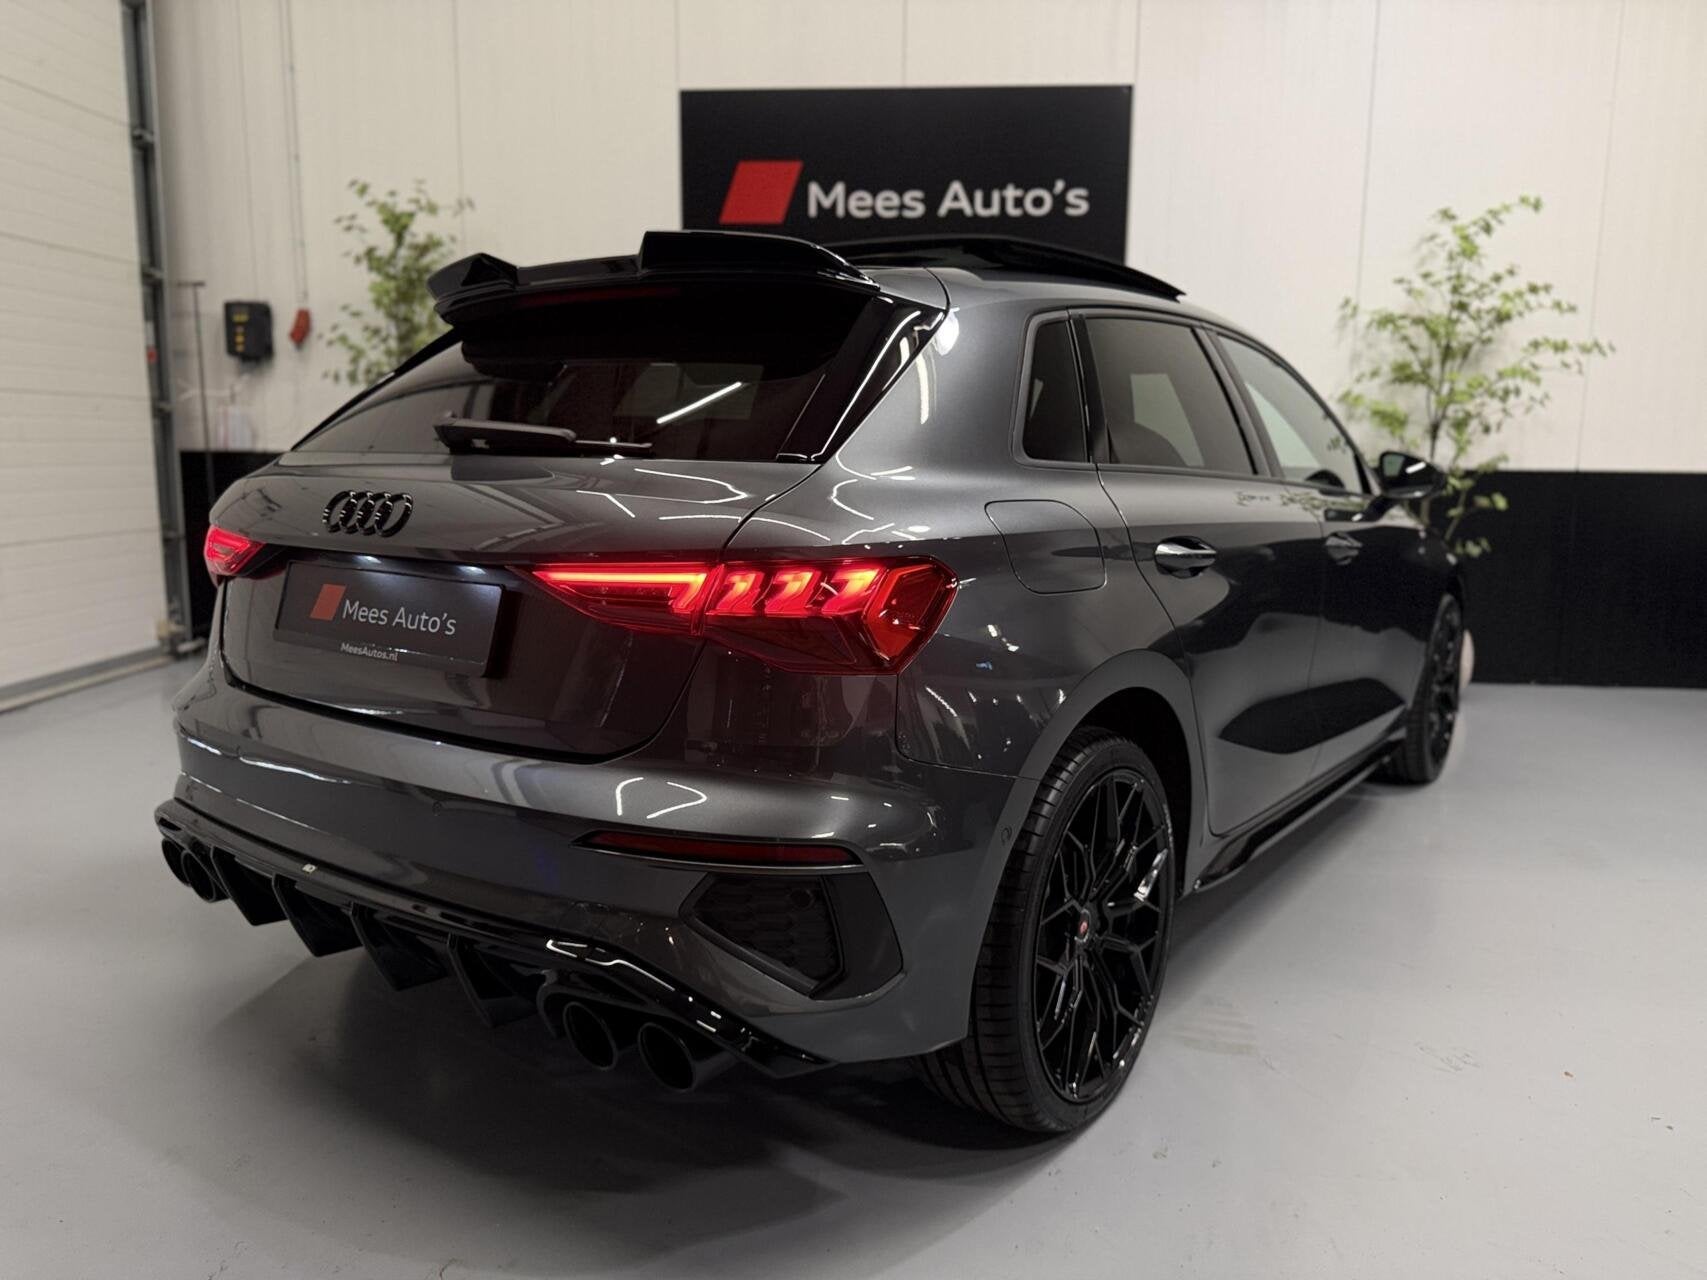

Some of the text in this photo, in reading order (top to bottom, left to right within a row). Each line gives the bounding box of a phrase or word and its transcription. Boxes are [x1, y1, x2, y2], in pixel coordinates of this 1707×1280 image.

[807, 179, 1090, 219] Mees Auto's
[341, 599, 457, 635] Mees Auto's
[340, 642, 399, 661] MeesAutos.nl
